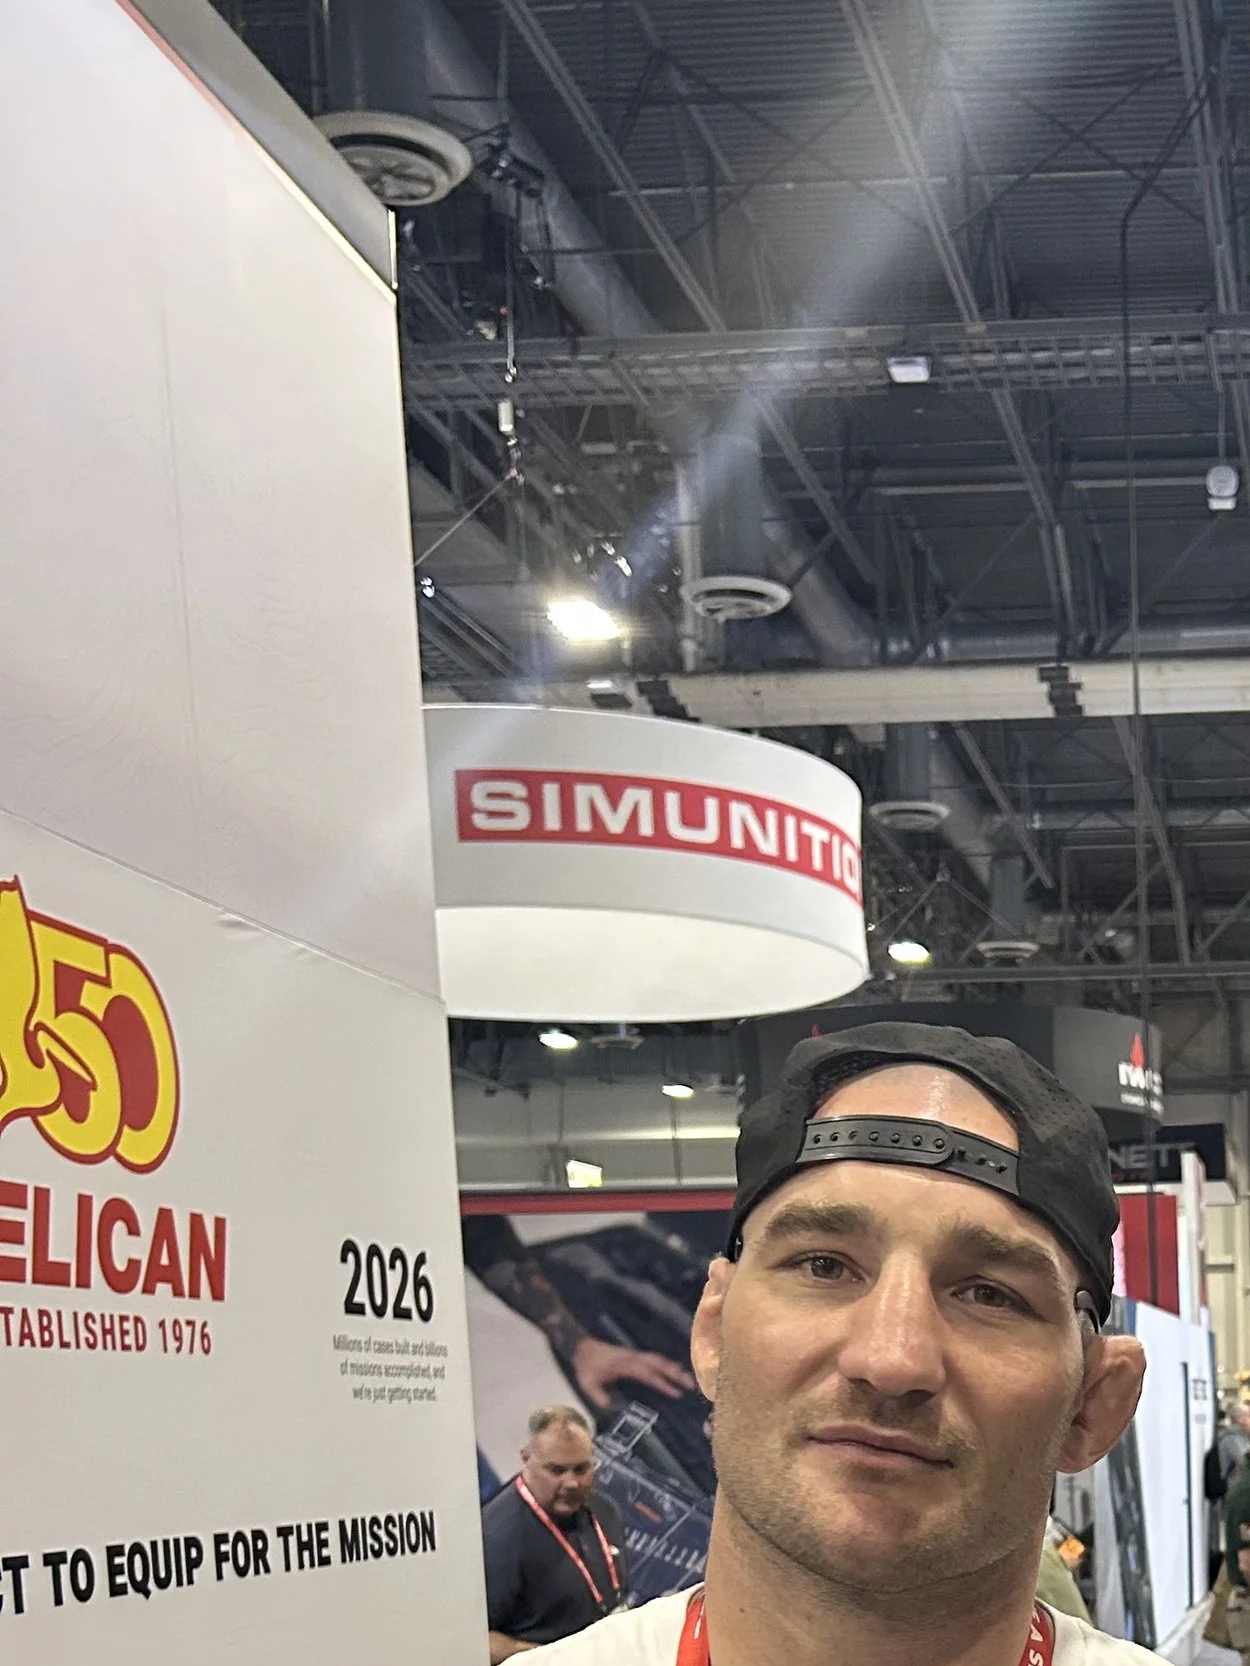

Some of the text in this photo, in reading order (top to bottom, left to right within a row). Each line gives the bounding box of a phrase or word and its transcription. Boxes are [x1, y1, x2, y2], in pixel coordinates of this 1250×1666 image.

[339, 1238, 435, 1323] 2026
[158, 1317, 212, 1356] 1976
[43, 1547, 95, 1607] TO
[107, 1534, 203, 1600] EQUIP
[214, 1527, 271, 1581] FOR
[276, 1518, 332, 1571] THE
[338, 1509, 437, 1564] MISSION
[1029, 1622, 1044, 1642] A
